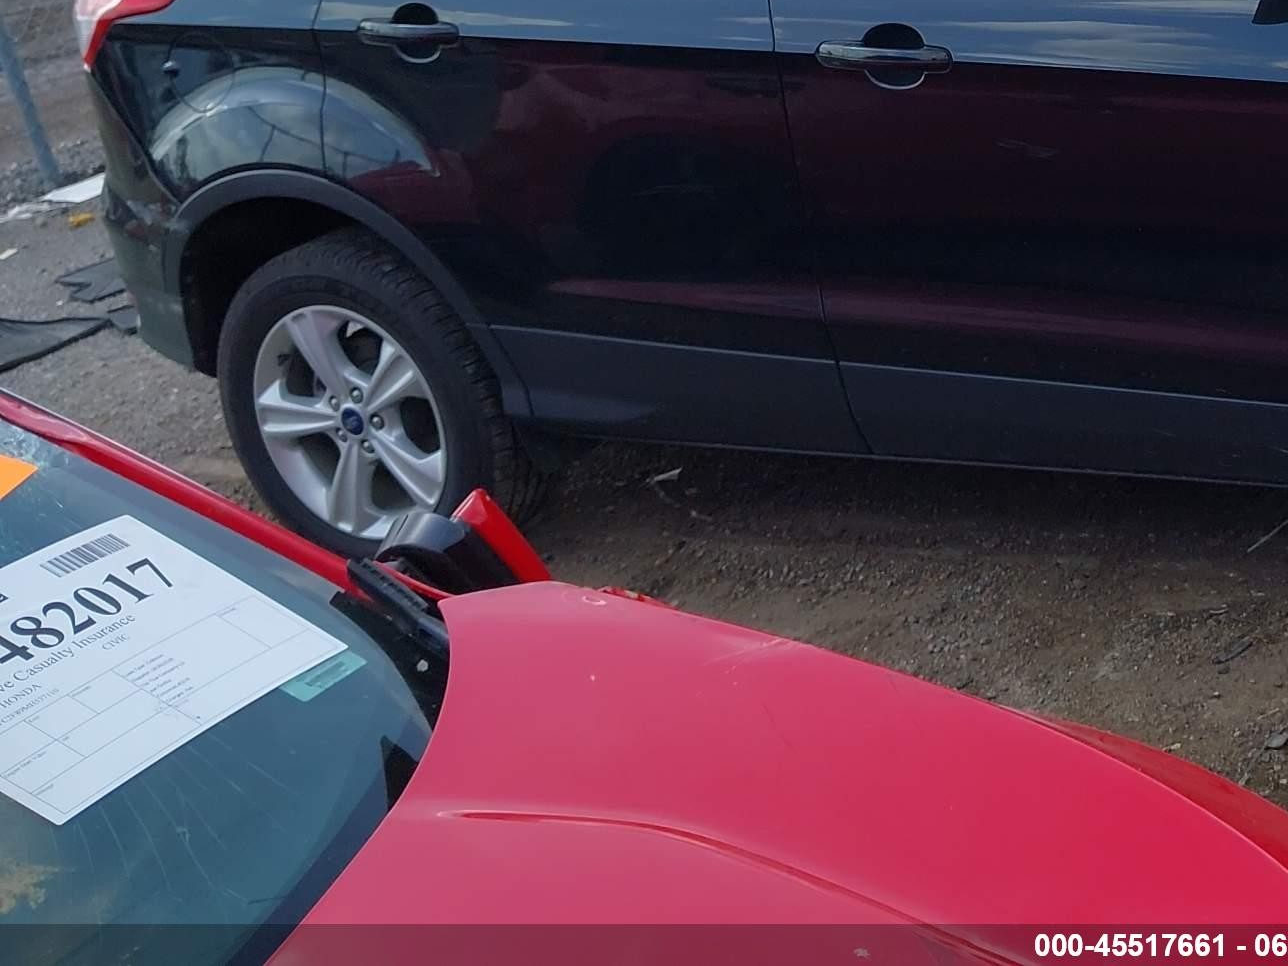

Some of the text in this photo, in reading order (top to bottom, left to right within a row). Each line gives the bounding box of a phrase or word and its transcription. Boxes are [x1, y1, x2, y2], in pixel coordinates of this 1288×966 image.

[0, 684, 42, 708] HONDA
[102, 633, 130, 651] CIVIC
[13, 646, 75, 681] Casualty
[71, 614, 136, 648] Insurance
